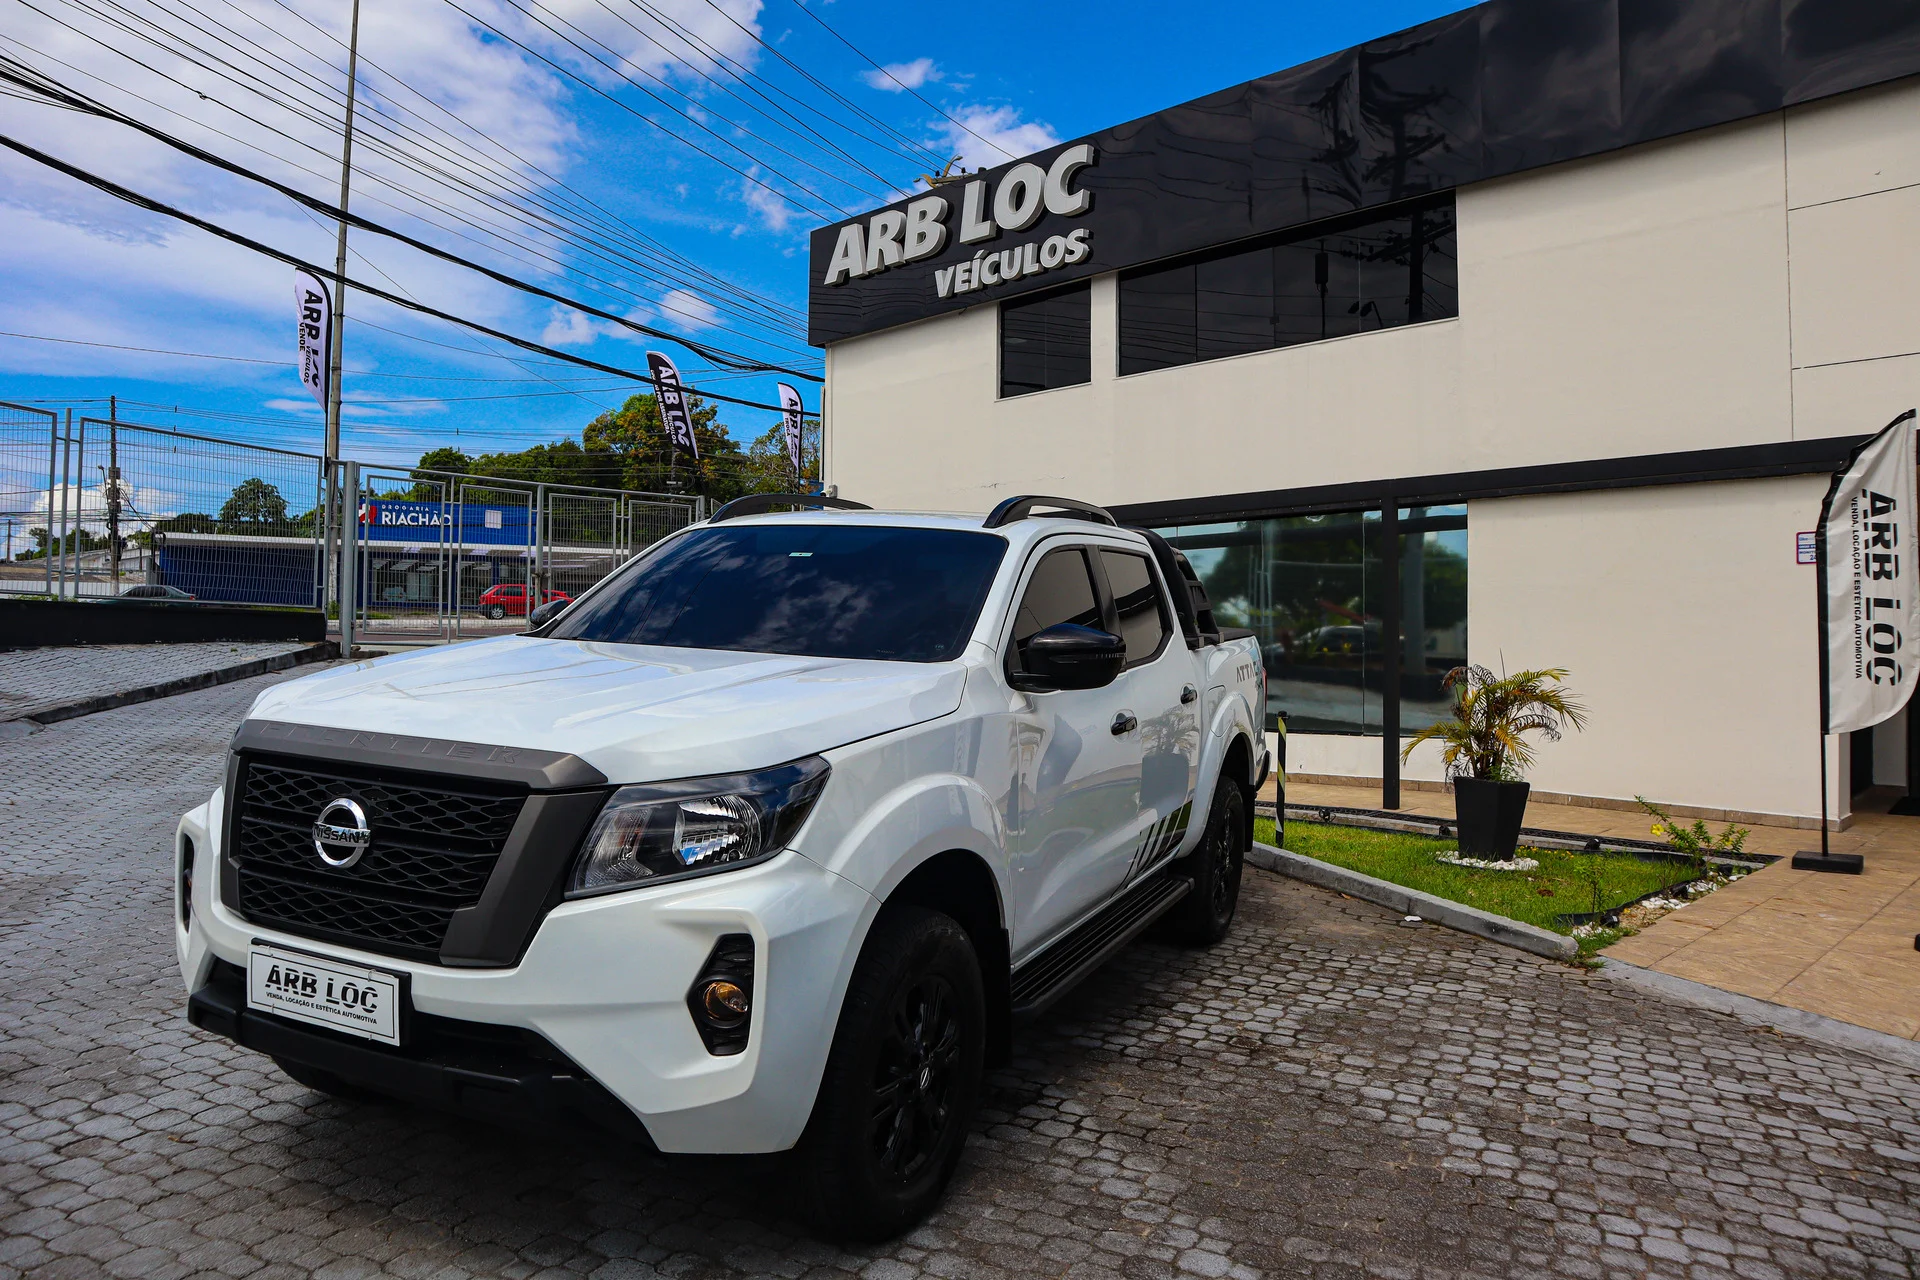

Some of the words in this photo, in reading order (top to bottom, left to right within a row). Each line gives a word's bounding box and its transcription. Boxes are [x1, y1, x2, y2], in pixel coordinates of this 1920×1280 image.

[824, 195, 949, 286] ARB
[959, 144, 1095, 245] LOC
[934, 228, 1090, 298] VEÍCULOS
[302, 289, 323, 341] ARB
[381, 504, 430, 512] DROGARIA
[381, 510, 452, 526] RIACHÃO
[1851, 496, 1860, 527] VENDA,
[1852, 529, 1862, 570] LOCAÇÃO
[1861, 488, 1900, 581] ARB
[1853, 579, 1863, 621] ESTÉTICA
[1854, 623, 1863, 679] AUTOMOTIVA
[1865, 597, 1903, 687] LOC
[313, 823, 364, 845] NISSAN
[264, 964, 318, 999] ARB
[325, 977, 379, 1014] LOC
[266, 991, 285, 1002] VENDA,
[285, 996, 310, 1008] LOCAÇÃO
[315, 1004, 341, 1016] ESTÉTICA
[341, 1011, 378, 1025] AUTOMOTIVA
